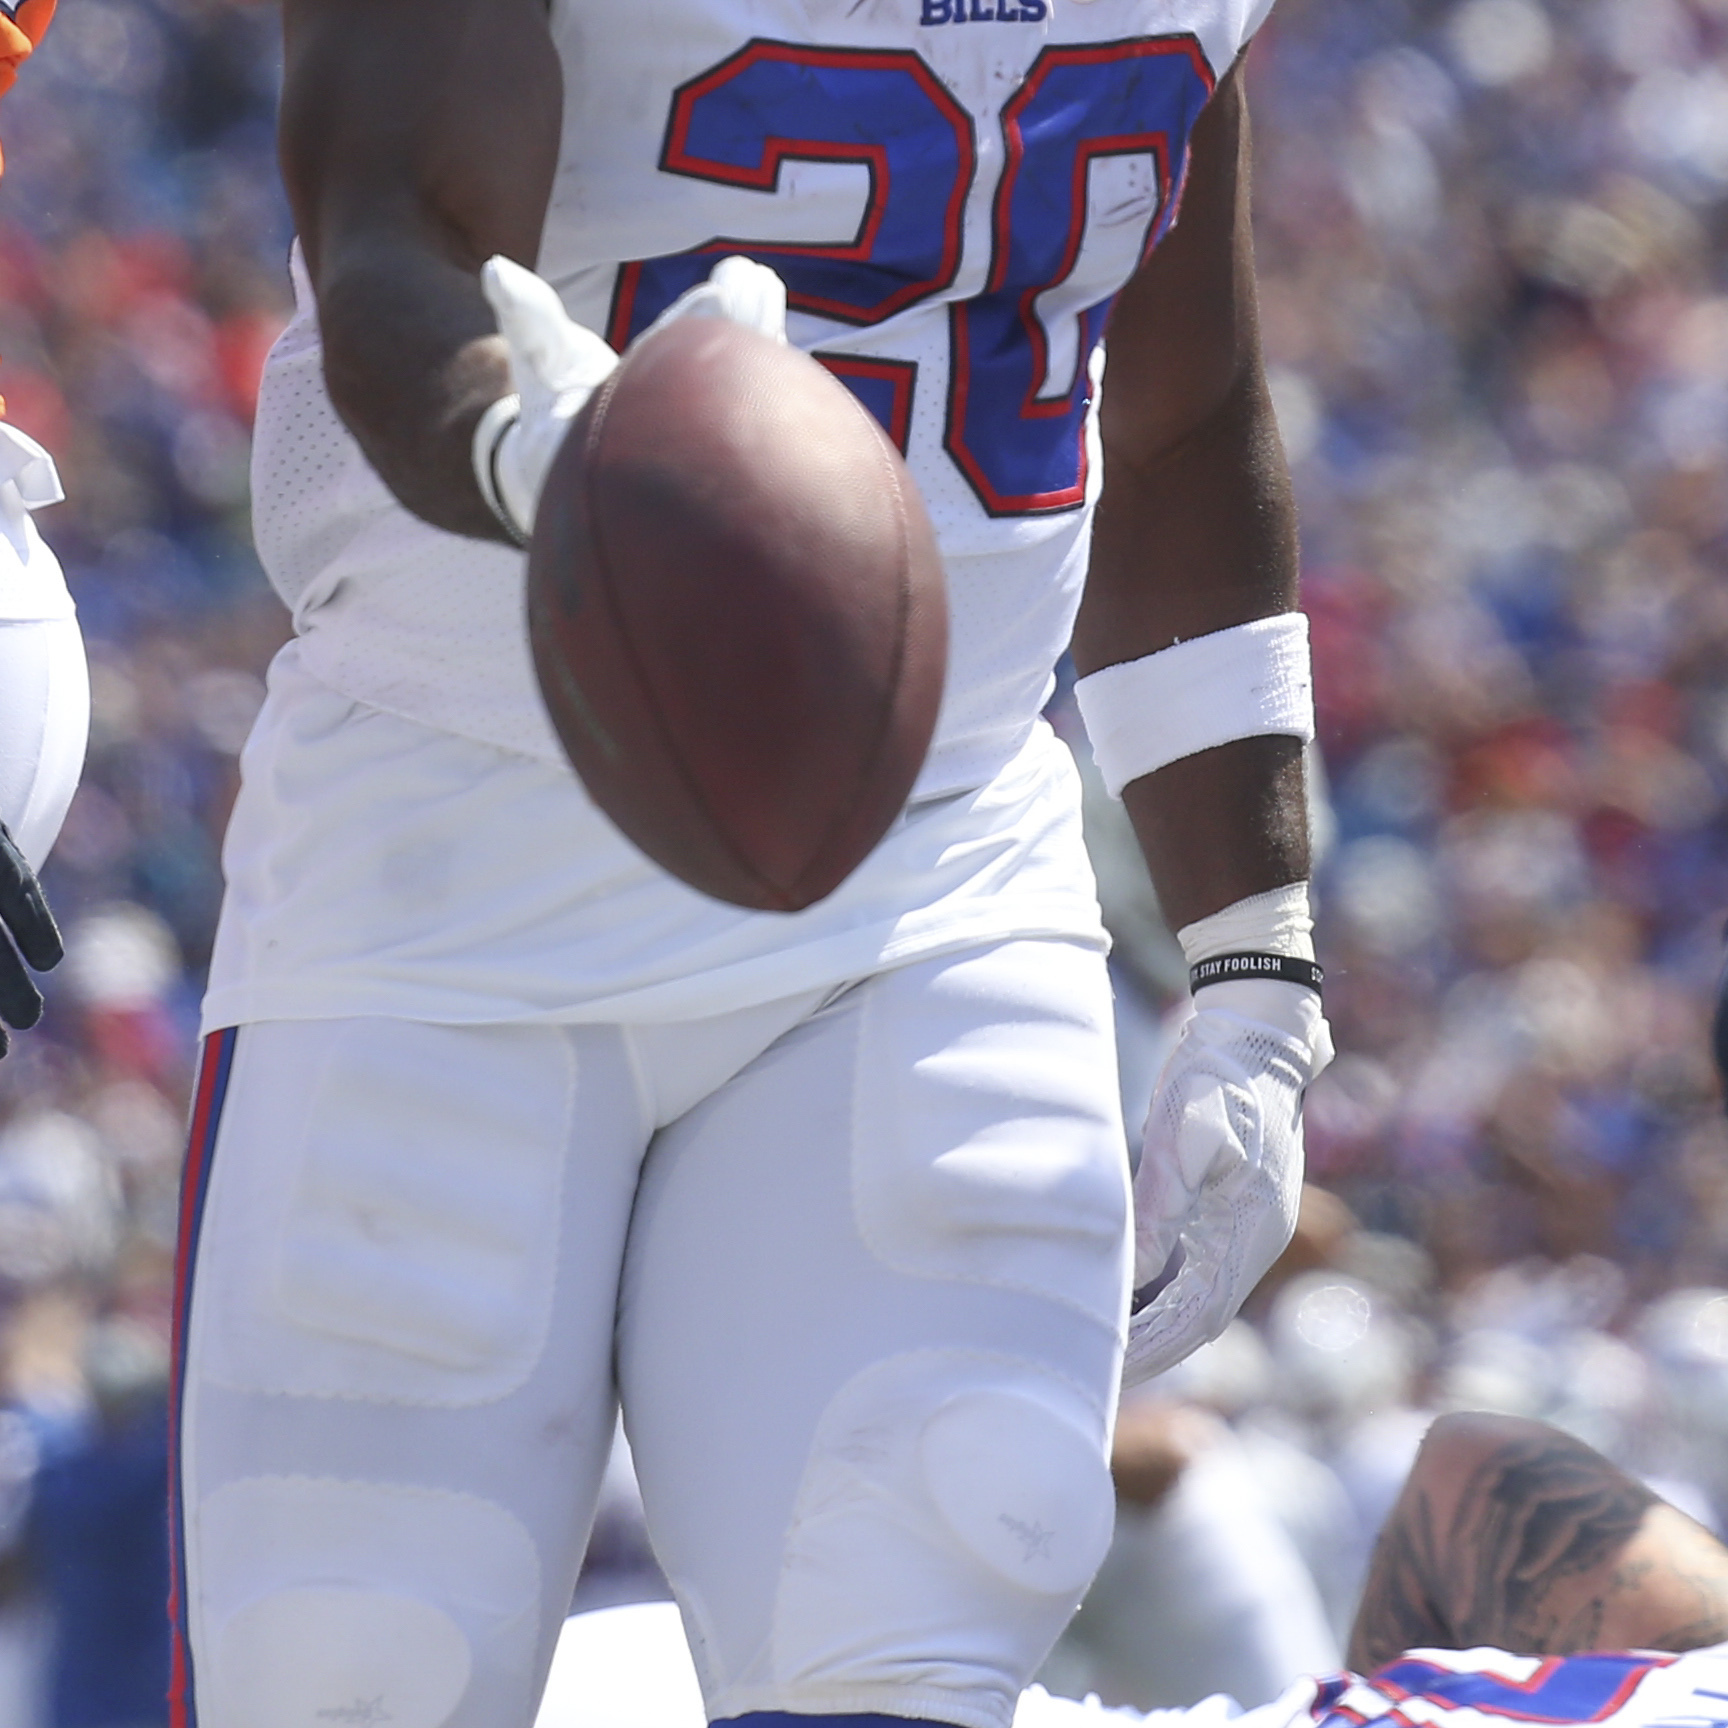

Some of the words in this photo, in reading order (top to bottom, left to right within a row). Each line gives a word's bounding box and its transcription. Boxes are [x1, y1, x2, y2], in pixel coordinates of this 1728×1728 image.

[605, 32, 1217, 518] 20
[1200, 960, 1222, 978] STAY
[1224, 957, 1282, 972] FOOLISH
